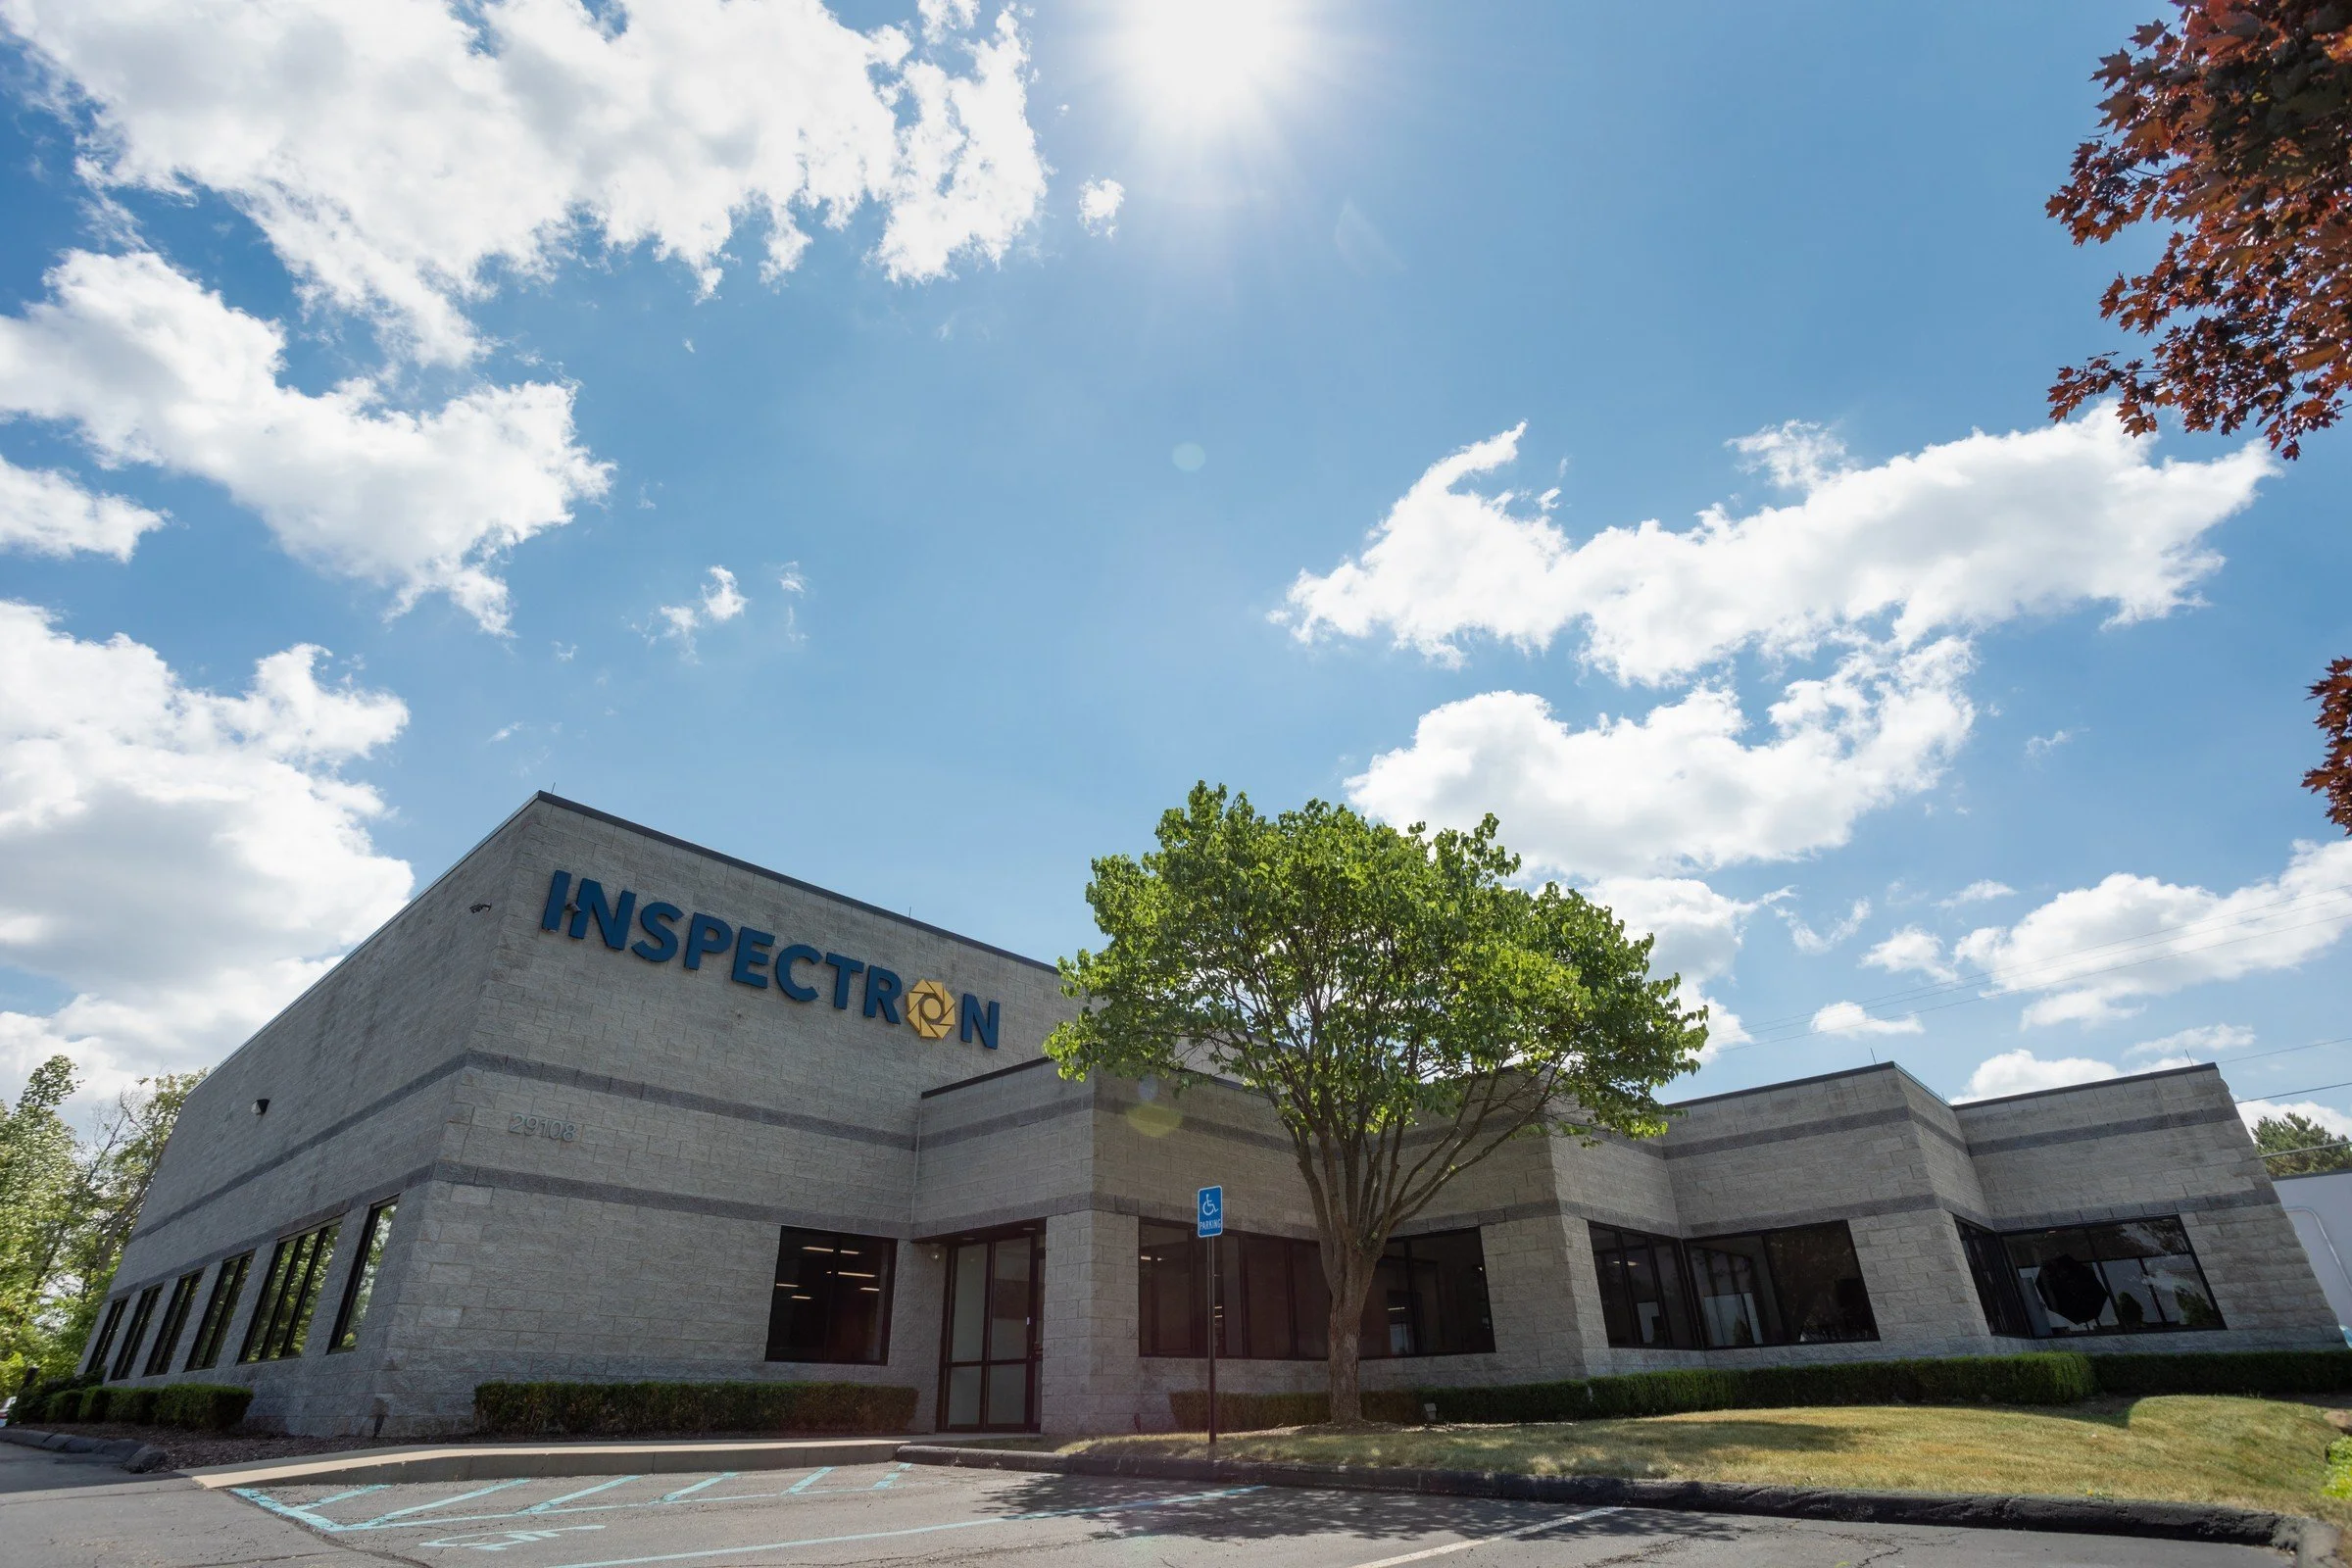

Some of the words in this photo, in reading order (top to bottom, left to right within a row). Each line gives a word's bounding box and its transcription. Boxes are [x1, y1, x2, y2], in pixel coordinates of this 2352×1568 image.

[541, 869, 1000, 1050] INSPECTRON
[509, 1112, 576, 1143] 29108
[1200, 1219, 1221, 1230] PARKING
